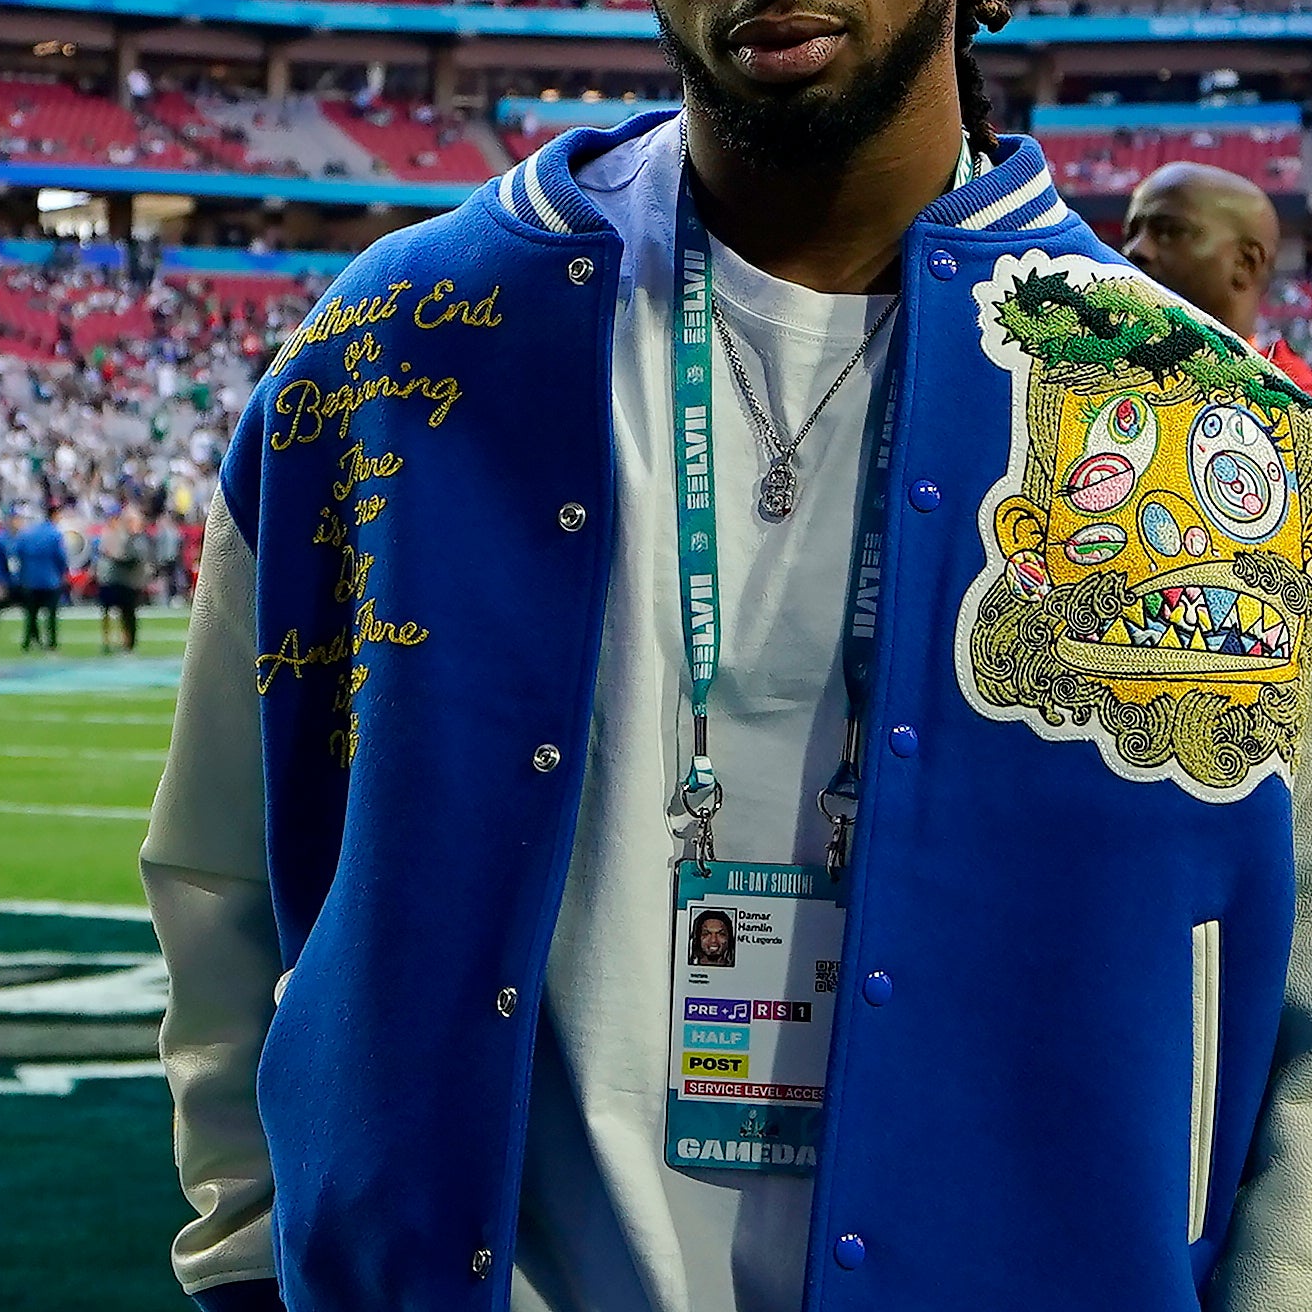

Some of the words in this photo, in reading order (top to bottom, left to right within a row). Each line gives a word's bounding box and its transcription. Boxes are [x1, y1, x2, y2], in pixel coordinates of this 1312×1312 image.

[413, 279, 503, 330] End
[684, 405, 709, 476] LVII
[728, 870, 768, 892] ALL-DAY
[771, 872, 813, 895] SIDELINE
[738, 910, 771, 921] Damar
[738, 922, 773, 933] Hamlin
[688, 1003, 718, 1016] PRE
[757, 1004, 768, 1016] R
[776, 1005, 787, 1017] S
[690, 1029, 743, 1045] HALF
[689, 1056, 743, 1072] POST
[689, 1082, 741, 1095] SERVICE
[744, 1086, 782, 1098] LEVEL
